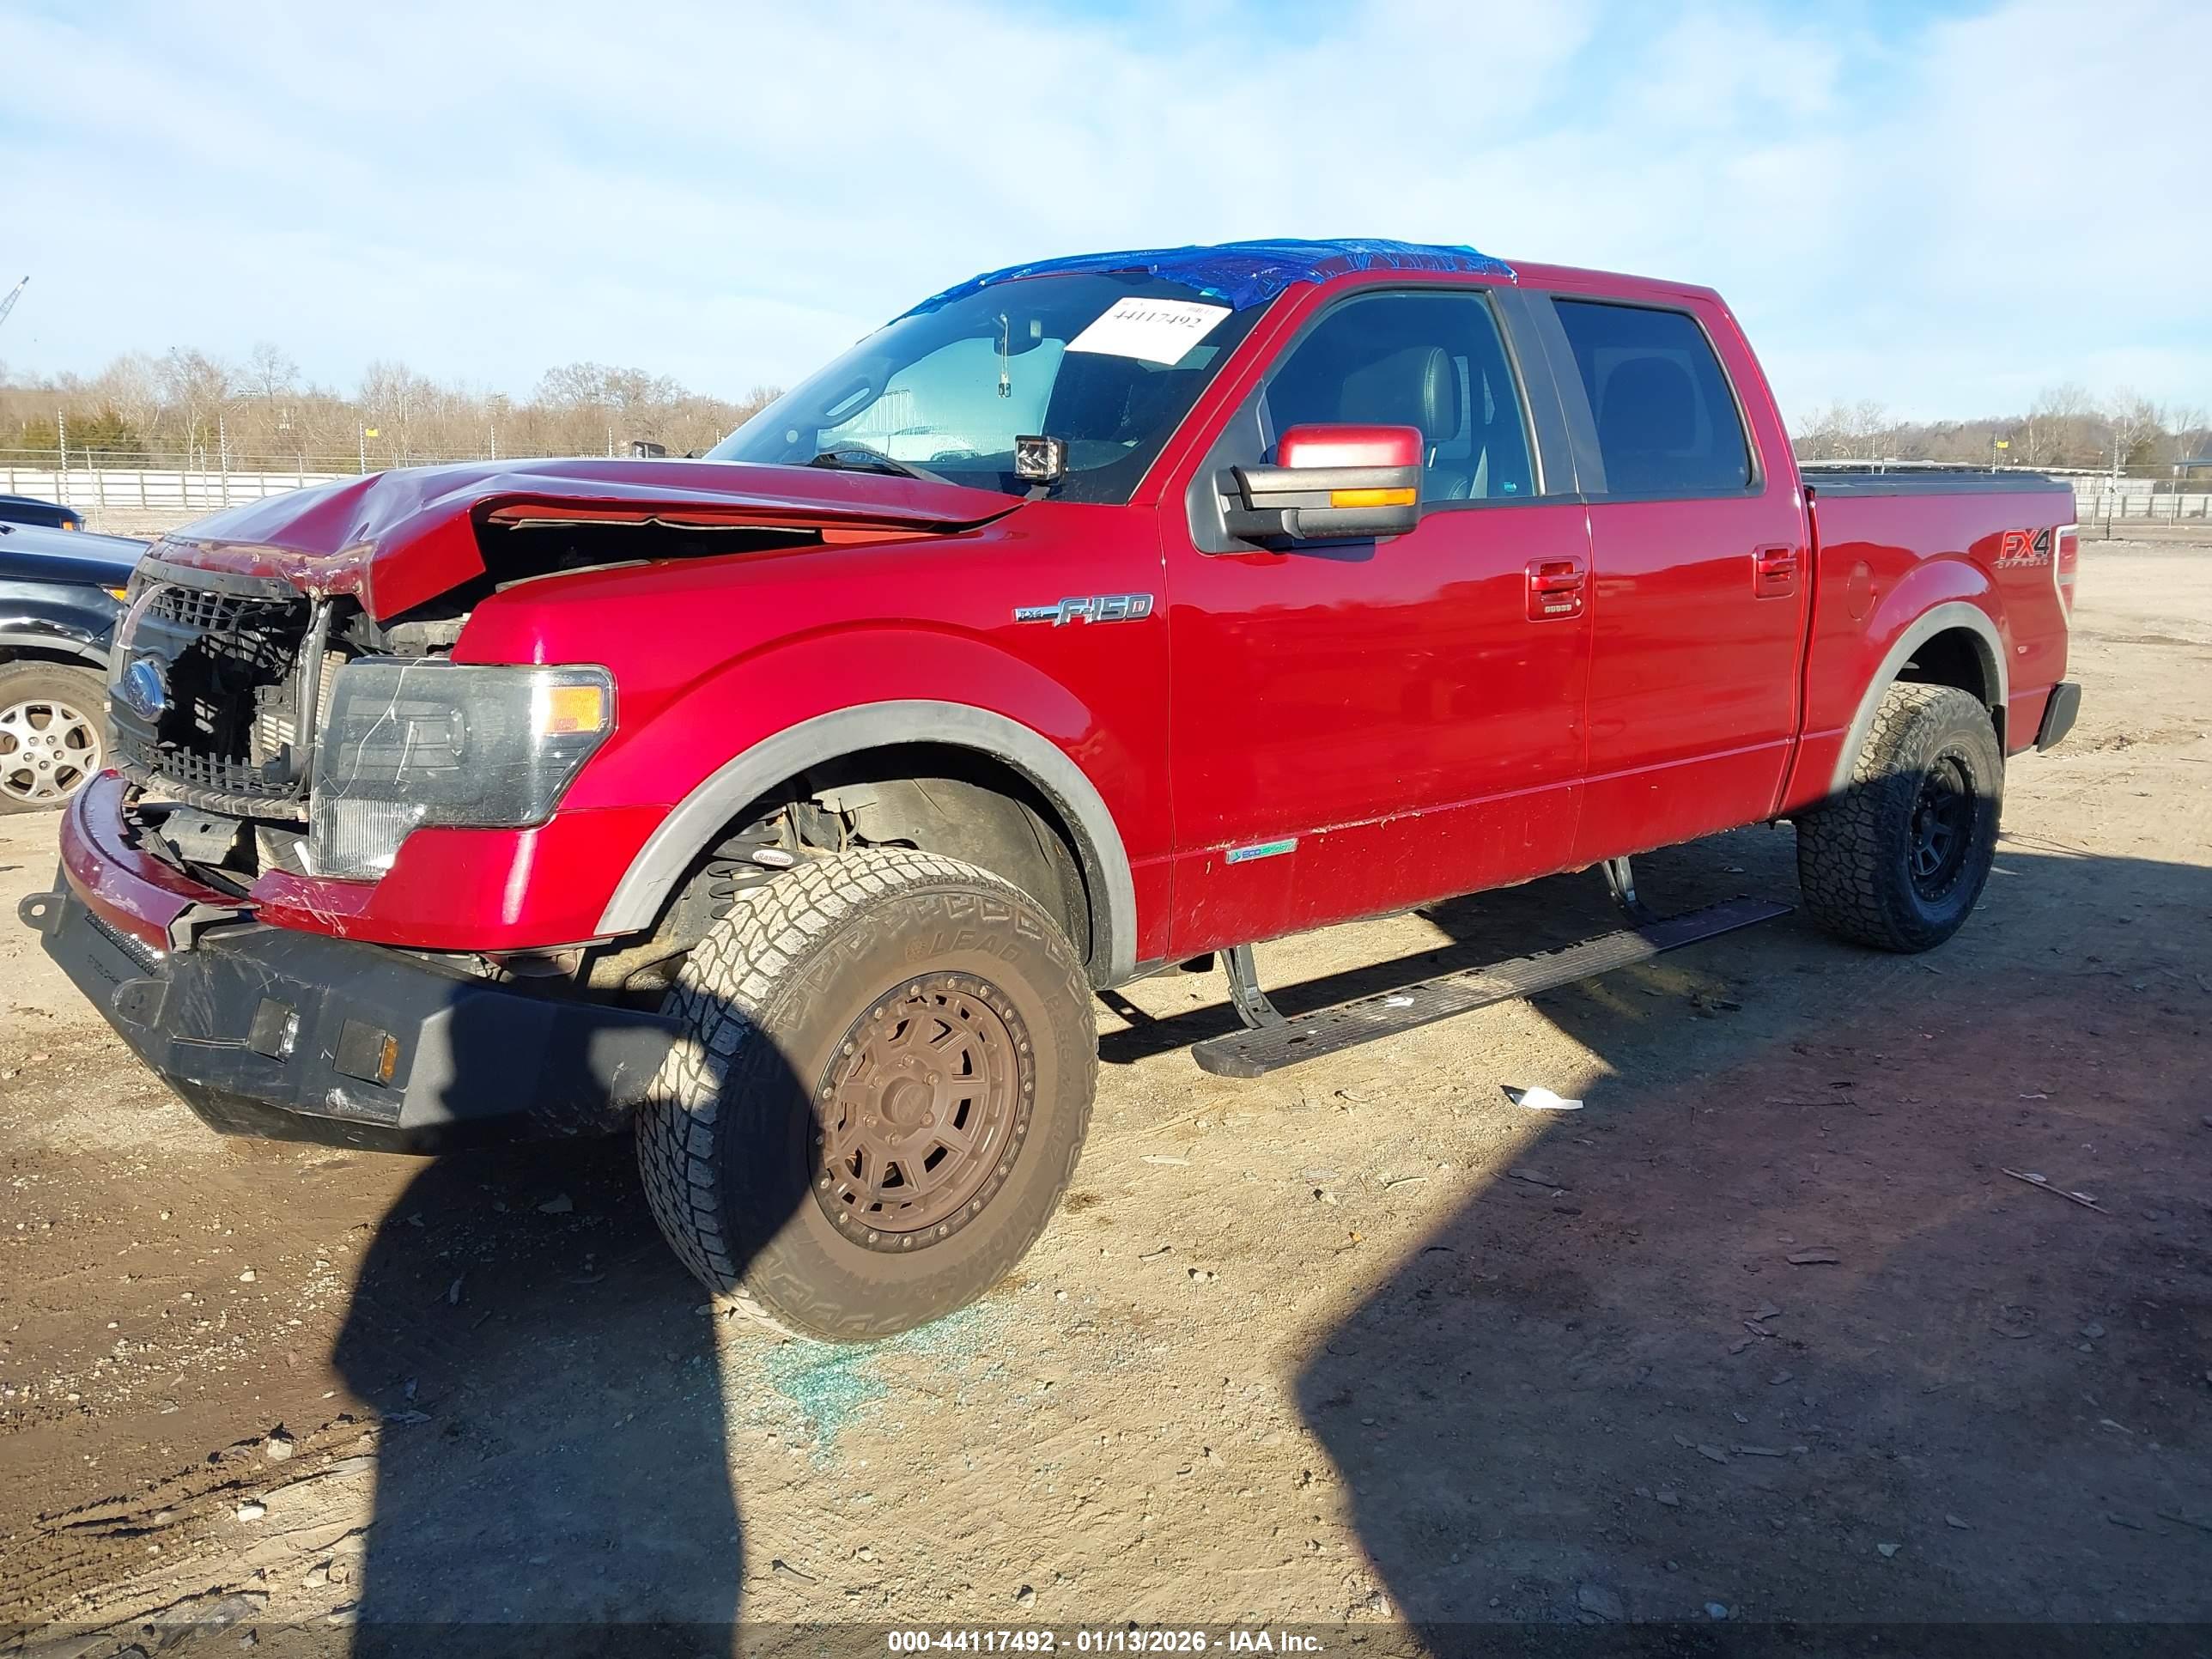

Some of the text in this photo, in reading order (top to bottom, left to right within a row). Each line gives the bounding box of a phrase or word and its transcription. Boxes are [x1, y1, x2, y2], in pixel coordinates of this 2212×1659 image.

[1114, 309, 1202, 328] 44117492
[1999, 527, 2051, 560] FX4
[1053, 594, 1153, 628] F-150
